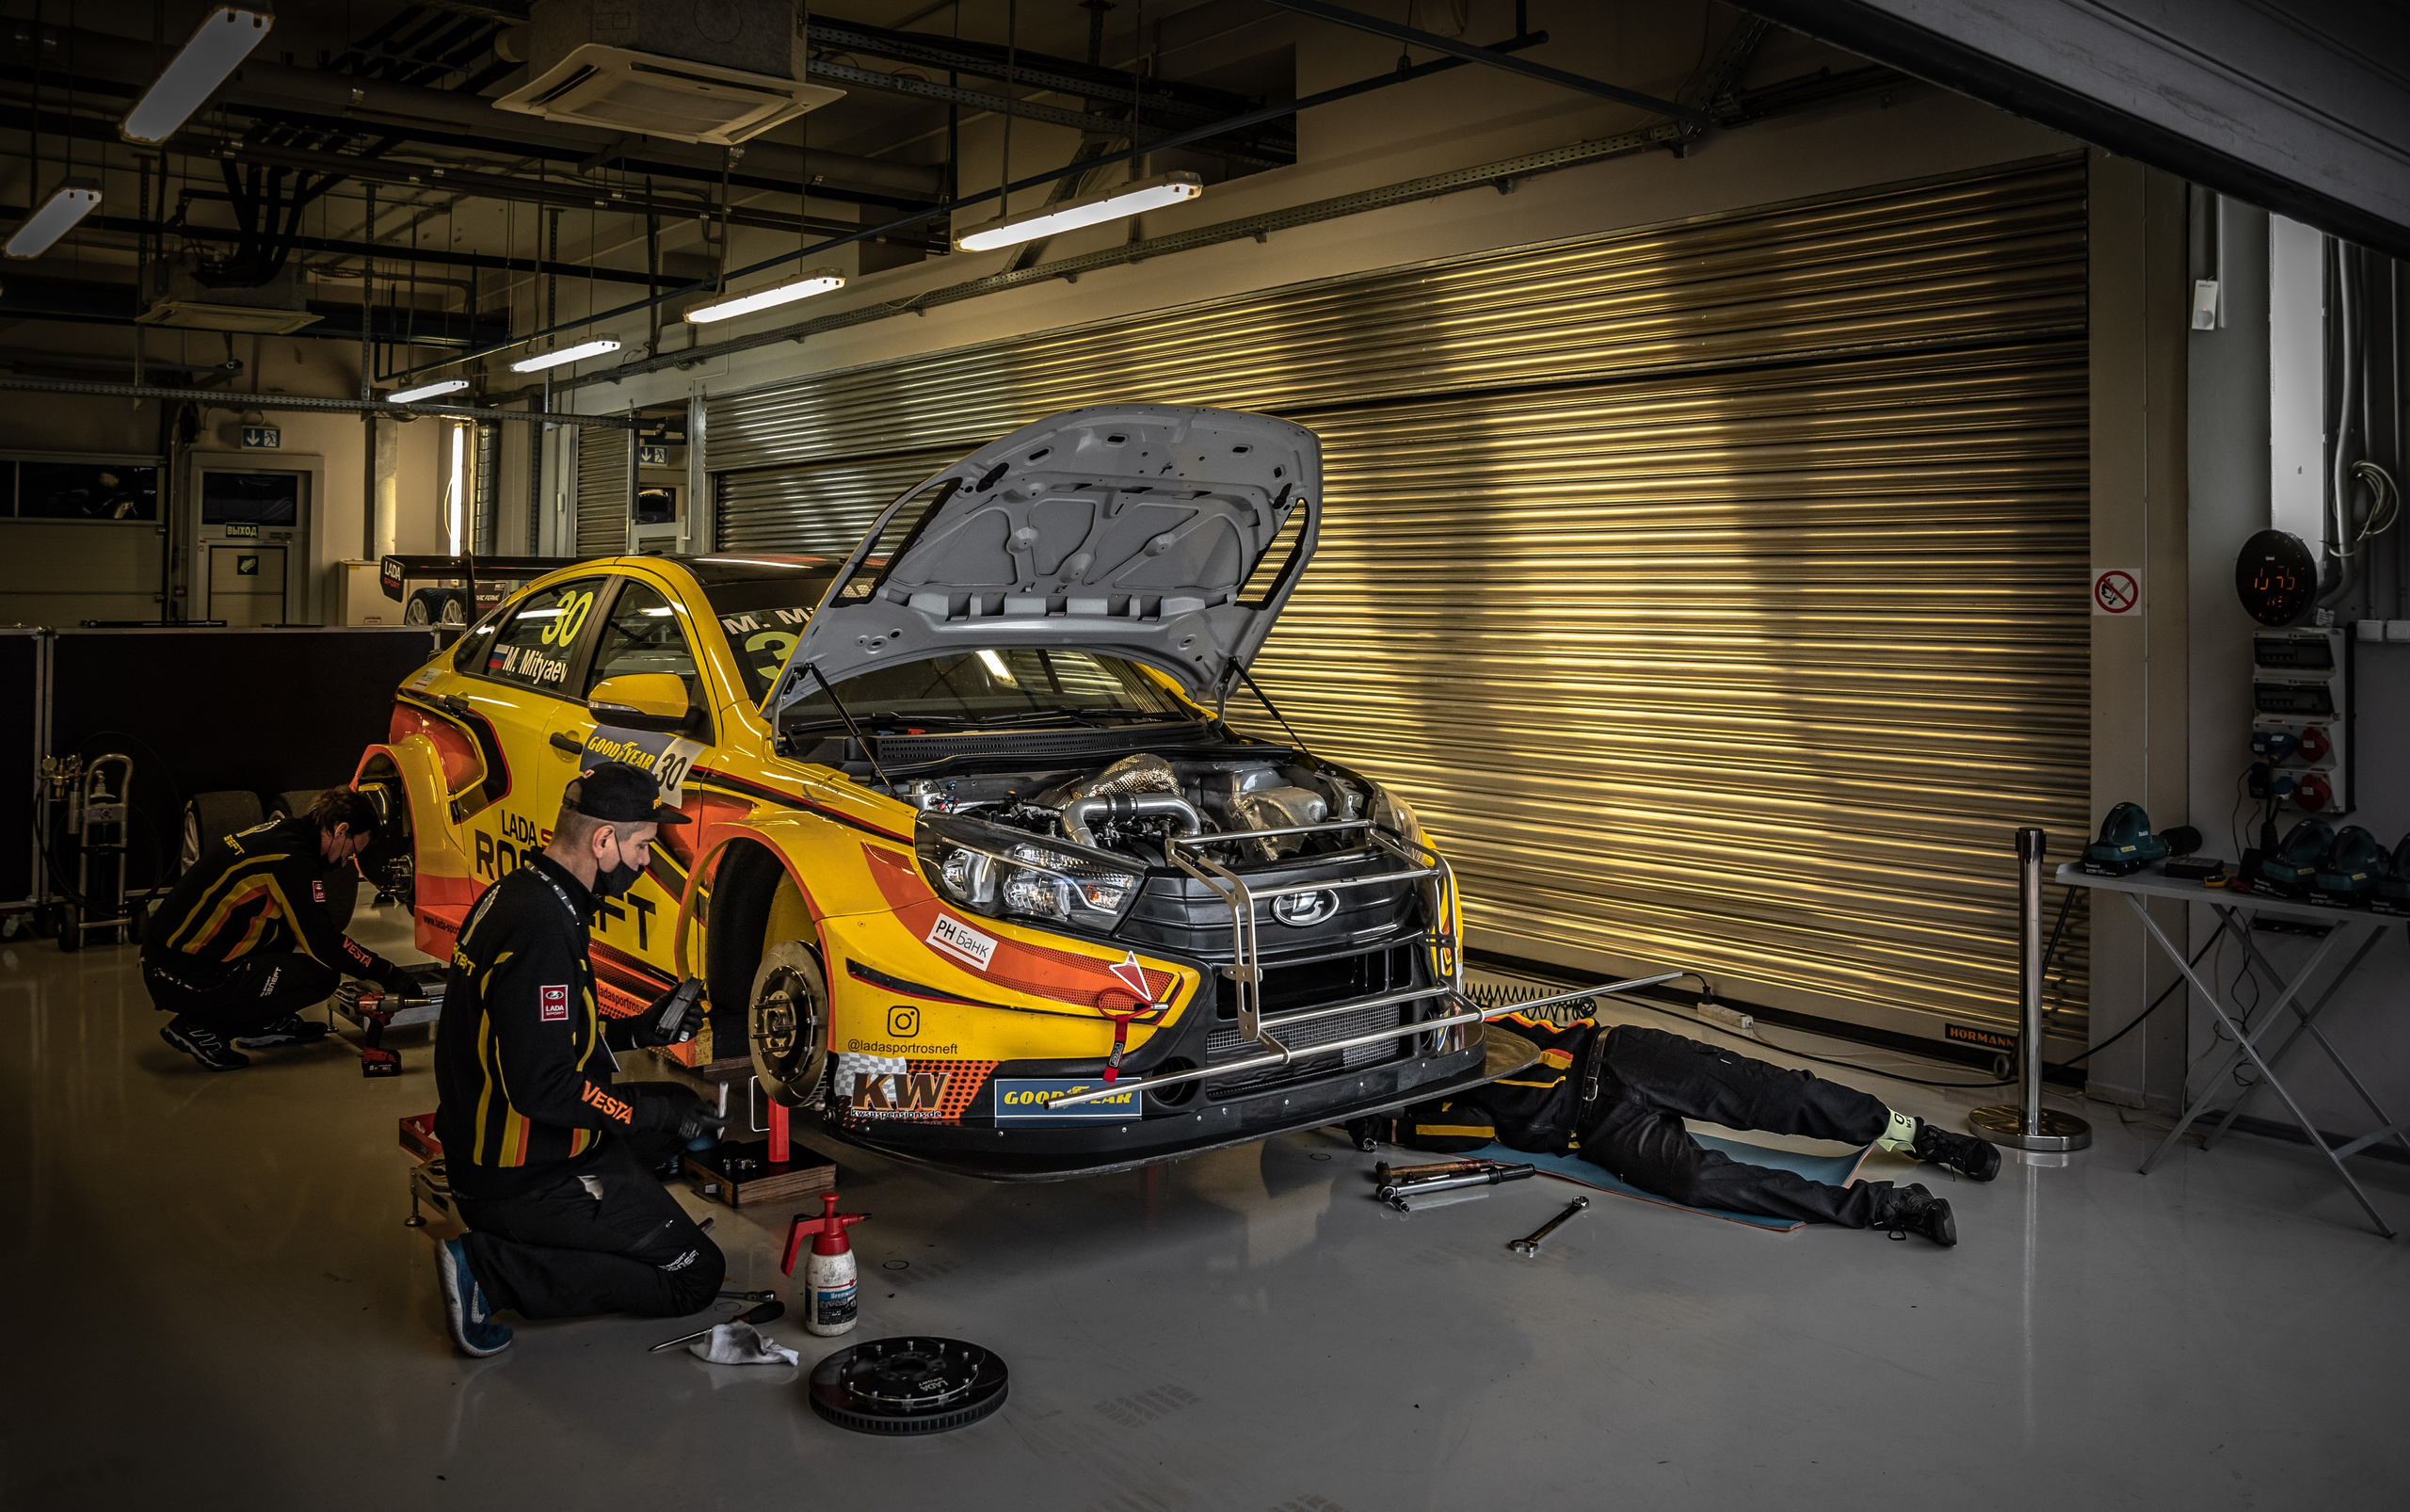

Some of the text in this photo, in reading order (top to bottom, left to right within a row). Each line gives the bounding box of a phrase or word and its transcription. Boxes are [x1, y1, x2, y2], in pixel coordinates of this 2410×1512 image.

[227, 525, 258, 538] ВЫХОД
[384, 560, 401, 582] LADA
[541, 589, 594, 648] 30
[502, 646, 569, 685] M. Mityaev
[587, 735, 656, 771] GOODYEAR
[653, 752, 687, 792] 30
[501, 809, 541, 847] LADA
[342, 935, 373, 968] VESTA
[956, 930, 989, 958] Банк
[847, 1038, 958, 1054] @ladasportrosneft
[580, 1080, 634, 1125] VESTA
[851, 1072, 952, 1111] KW
[850, 1109, 942, 1120] kwsuspensions.de
[920, 1380, 949, 1392] LADA
